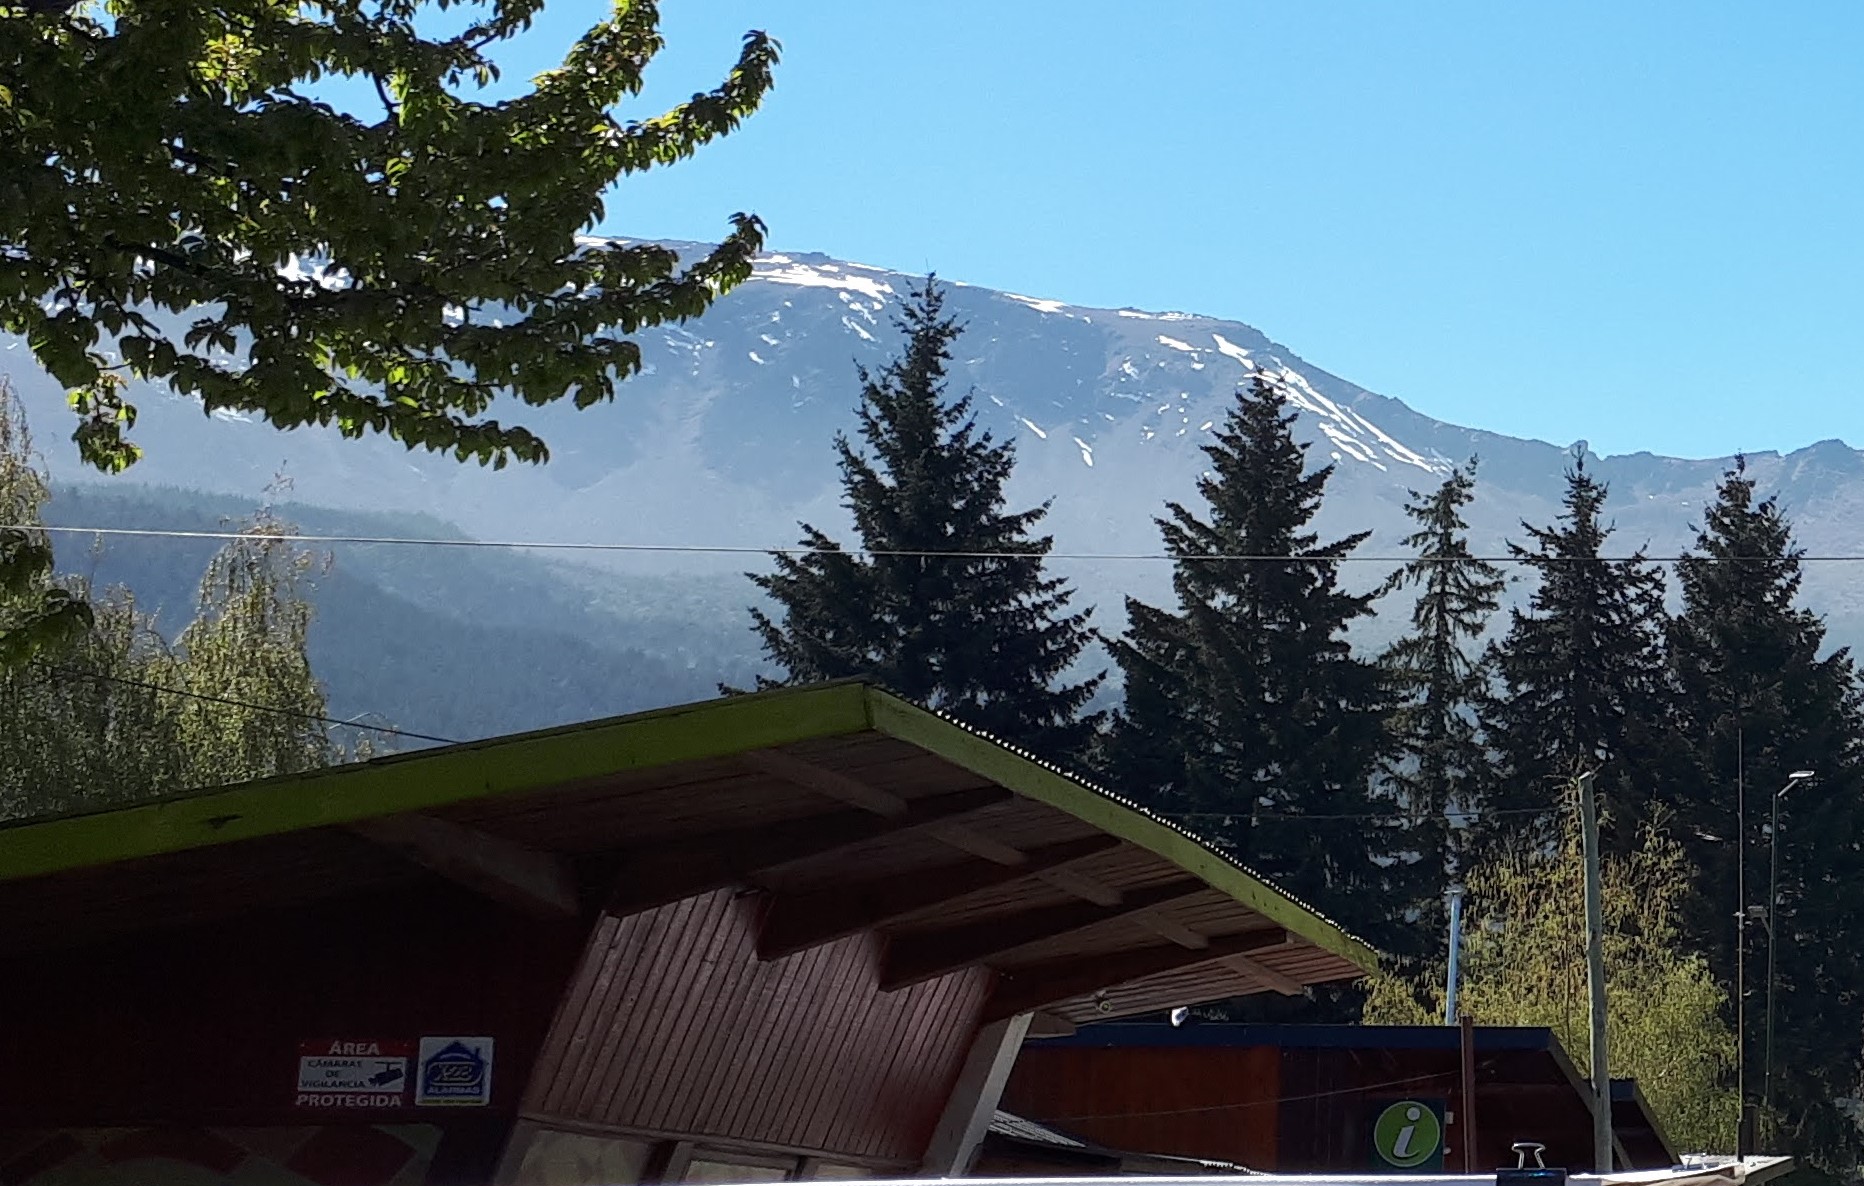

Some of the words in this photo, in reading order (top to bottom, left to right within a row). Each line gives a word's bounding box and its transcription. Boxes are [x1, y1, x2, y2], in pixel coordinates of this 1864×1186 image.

[329, 1040, 380, 1055] ÁREA
[325, 1070, 340, 1078] DE
[302, 1079, 366, 1088] VIGILANCIA
[295, 1094, 402, 1107] PROTEGIDA
